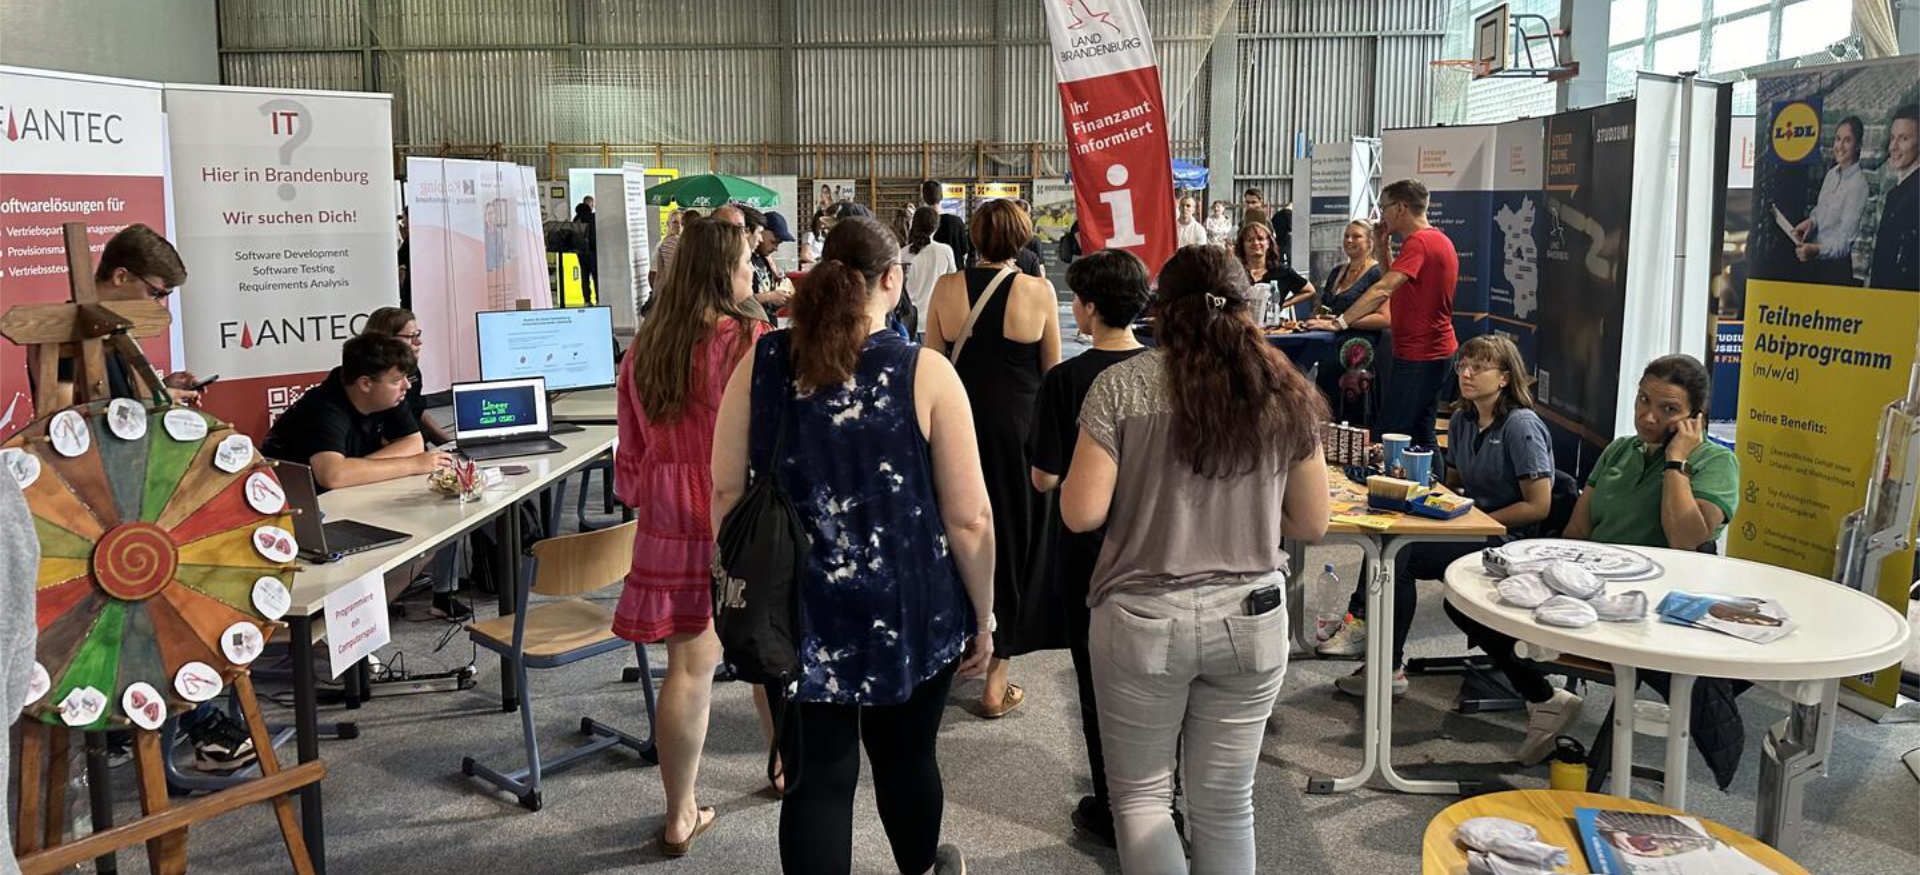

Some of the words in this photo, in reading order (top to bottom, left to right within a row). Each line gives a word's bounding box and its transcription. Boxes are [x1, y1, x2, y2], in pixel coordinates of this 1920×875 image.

[1071, 33, 1101, 48] LAND
[1060, 38, 1141, 62] BRANDENBURG
[1069, 101, 1090, 116] Ihr
[272, 112, 299, 135] IT
[1072, 101, 1152, 136] Finanzamt
[1075, 122, 1154, 155] informiert
[1597, 125, 1629, 143] STUDIUM
[202, 168, 240, 182] Hier
[244, 168, 259, 182] in
[265, 168, 369, 185] Brandenburg
[0, 197, 105, 215] oftwarelösungen
[107, 197, 126, 212] für
[223, 212, 253, 224] Wir
[258, 211, 313, 224] suchen
[319, 210, 357, 223] Dich!
[235, 250, 281, 261] Software
[283, 249, 349, 261] Development
[253, 265, 298, 275] Software
[301, 263, 335, 274] Testing
[239, 280, 308, 292] Requirements
[310, 277, 349, 289] Analysis
[1758, 304, 1863, 335] Teilnehmer
[1754, 333, 1893, 370] Abiprogramm
[1752, 362, 1799, 383] (m/w/d)
[1750, 408, 1778, 424] Deine
[1781, 414, 1827, 434] Benefits:
